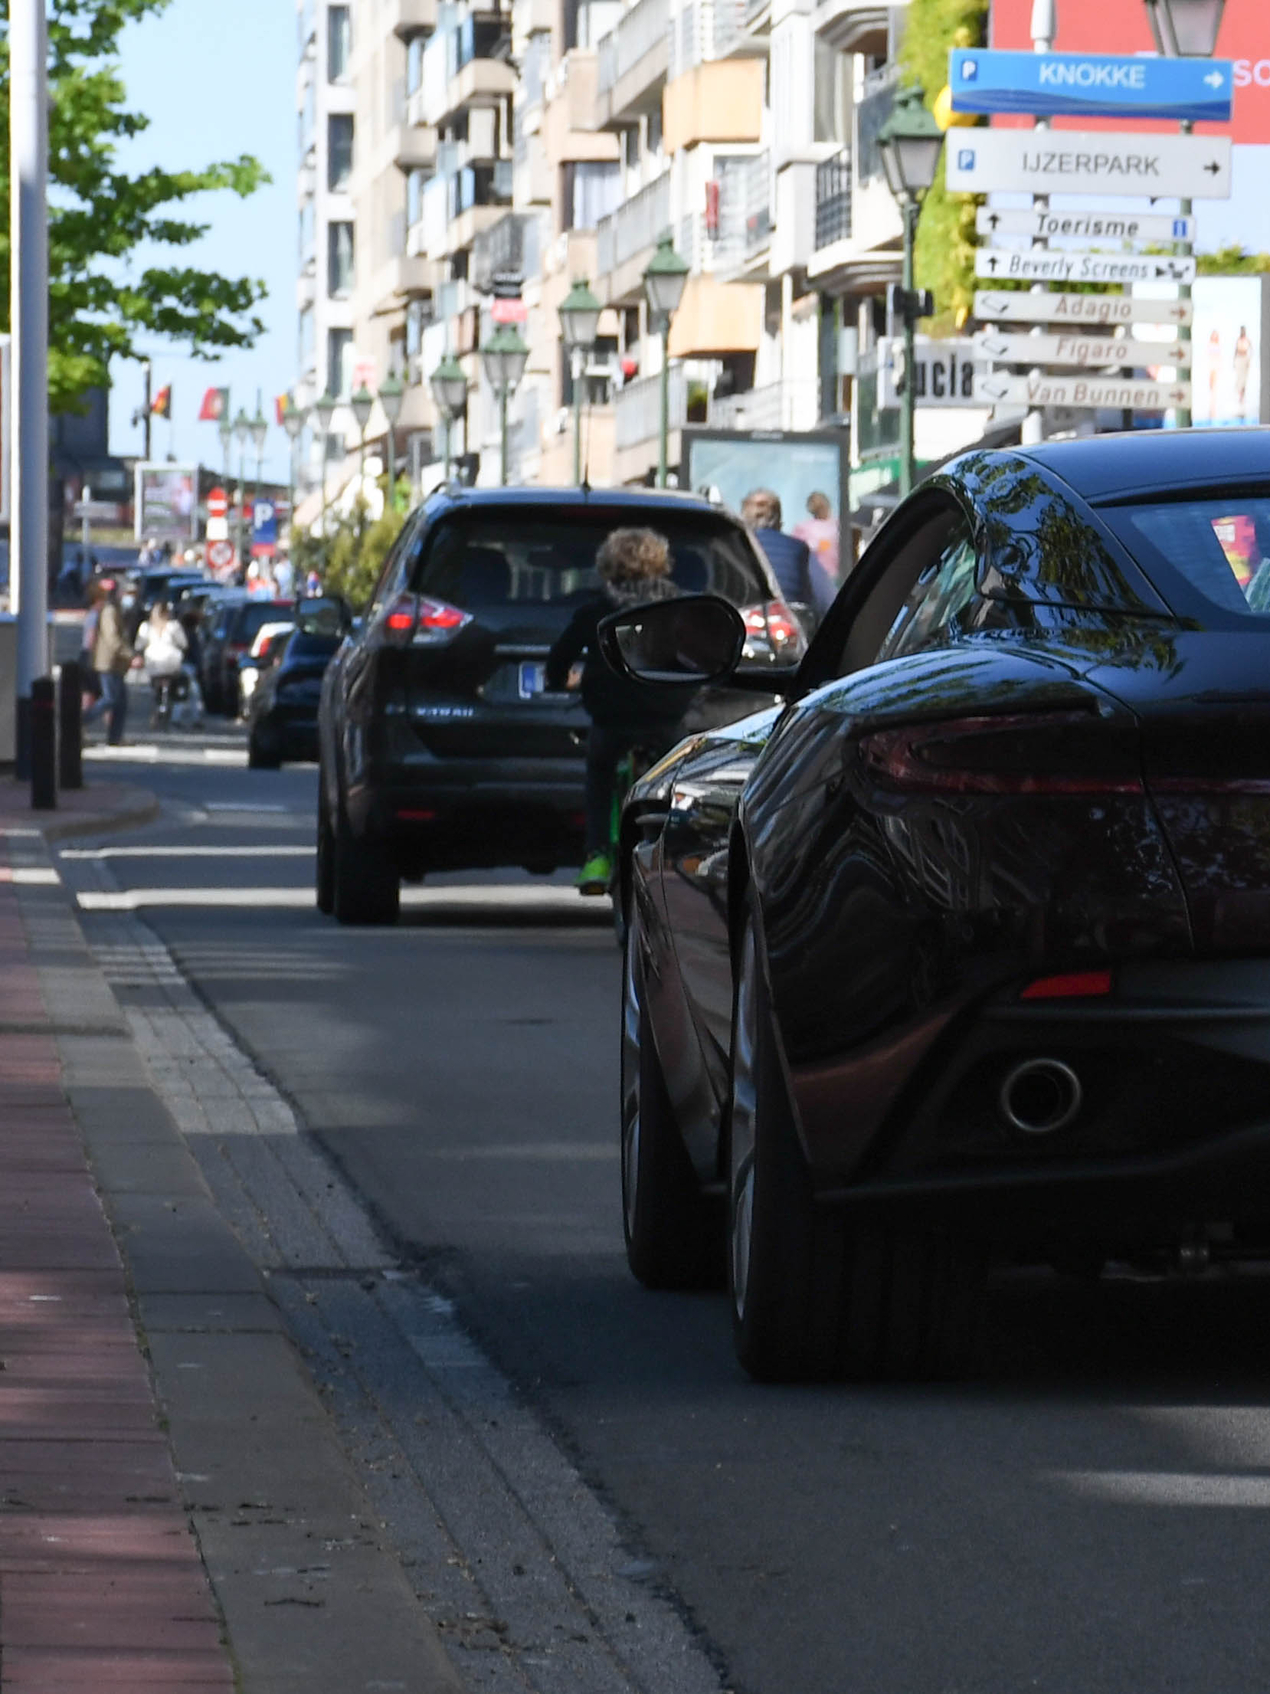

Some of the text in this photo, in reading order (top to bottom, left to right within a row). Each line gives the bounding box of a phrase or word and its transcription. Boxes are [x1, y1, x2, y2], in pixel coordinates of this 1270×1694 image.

[1039, 62, 1146, 89] KNOKKE
[1021, 152, 1160, 176] IJZERPARK
[1037, 214, 1140, 238] Toerisme
[1009, 255, 1149, 280] Beverly Screens
[1054, 296, 1132, 323] Adagio
[1056, 337, 1128, 365] Figaro
[1027, 382, 1160, 406] Van Bunnen
